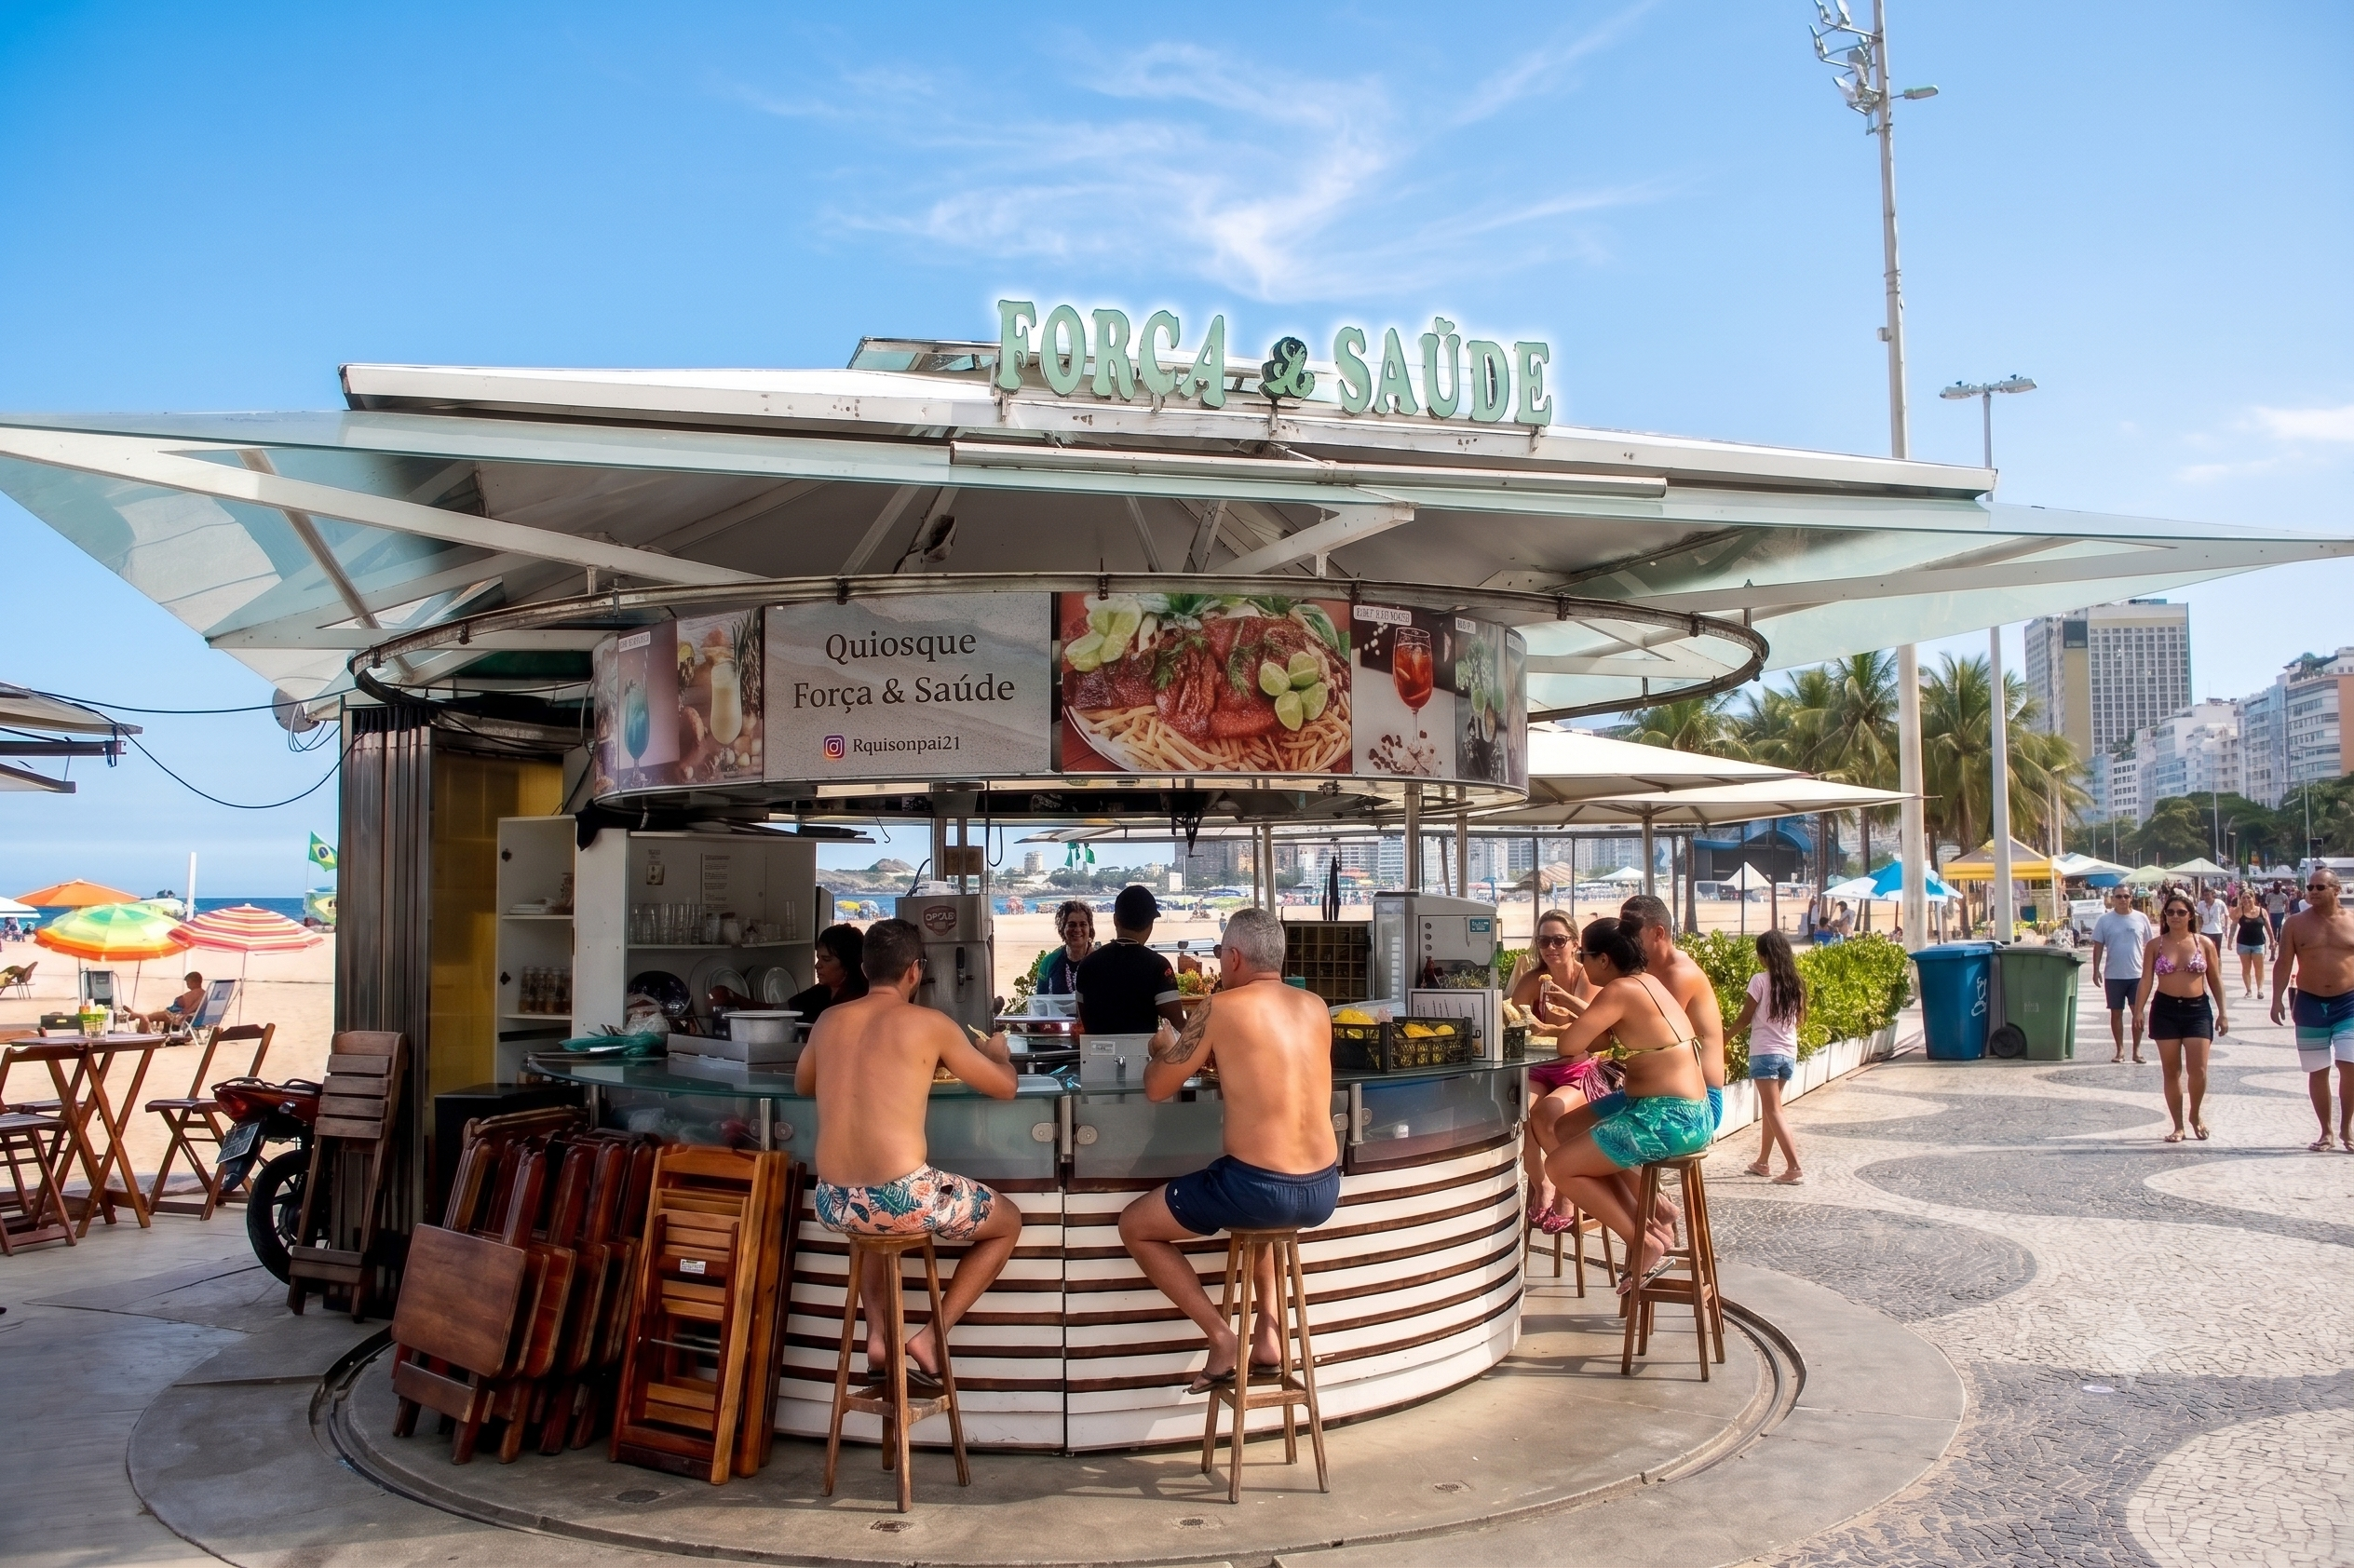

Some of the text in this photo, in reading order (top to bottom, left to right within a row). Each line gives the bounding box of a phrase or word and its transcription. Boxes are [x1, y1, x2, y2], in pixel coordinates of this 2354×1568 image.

[1258, 336, 1315, 400] &
[825, 630, 977, 665] Quiosque
[793, 672, 1015, 714] Força & Saúde
[852, 736, 960, 756] Rquisonpai21
